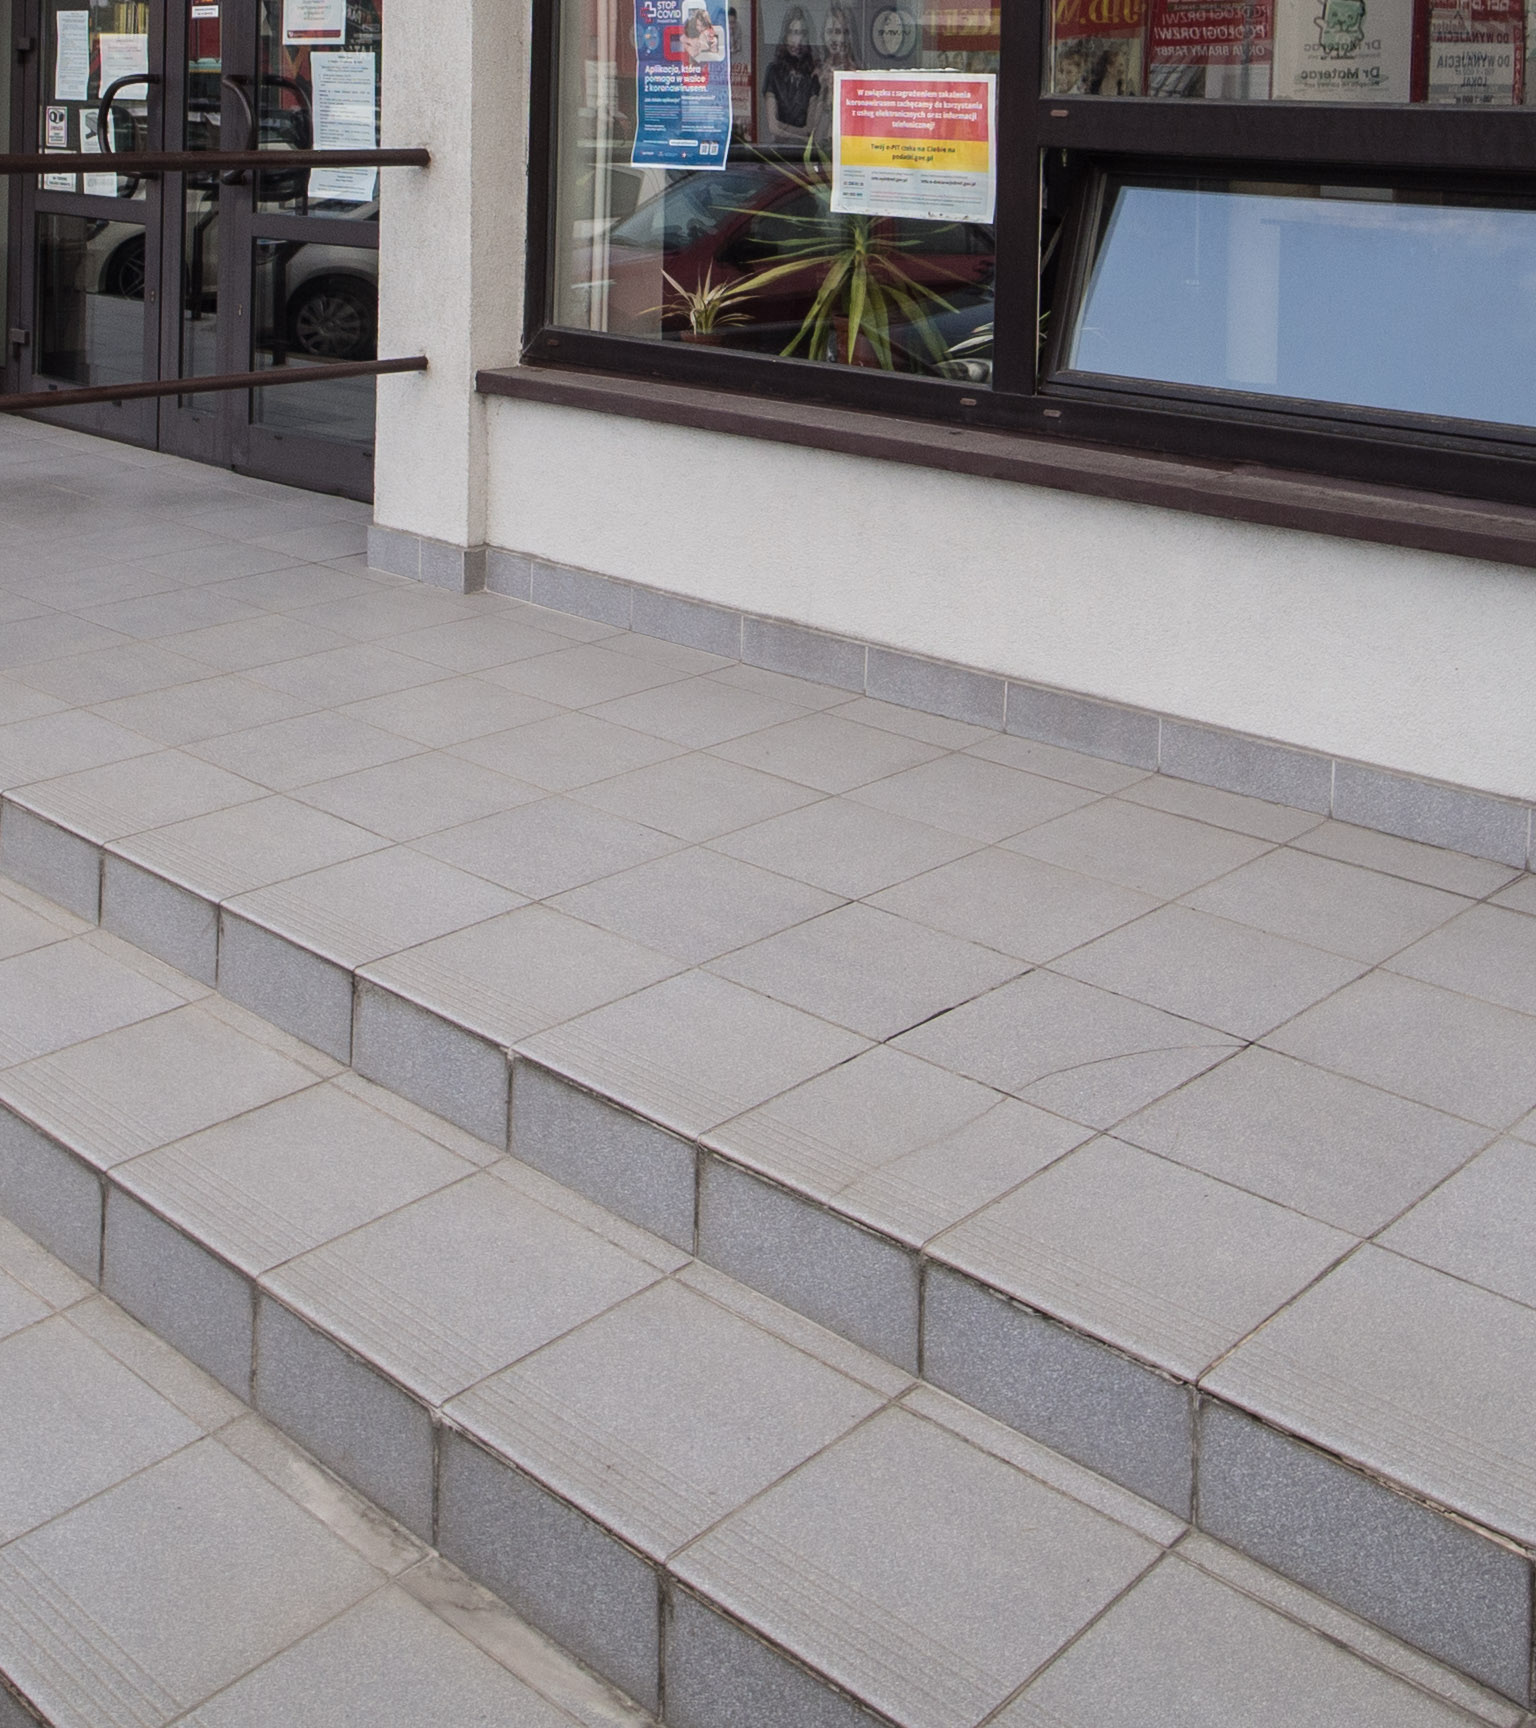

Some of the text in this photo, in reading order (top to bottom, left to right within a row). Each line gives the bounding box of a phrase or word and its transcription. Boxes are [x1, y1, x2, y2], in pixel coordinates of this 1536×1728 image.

[657, 1, 677, 10] STOP
[657, 9, 682, 19] COVID
[645, 64, 701, 76] Aplikacja, która
[644, 75, 676, 86] pomaga
